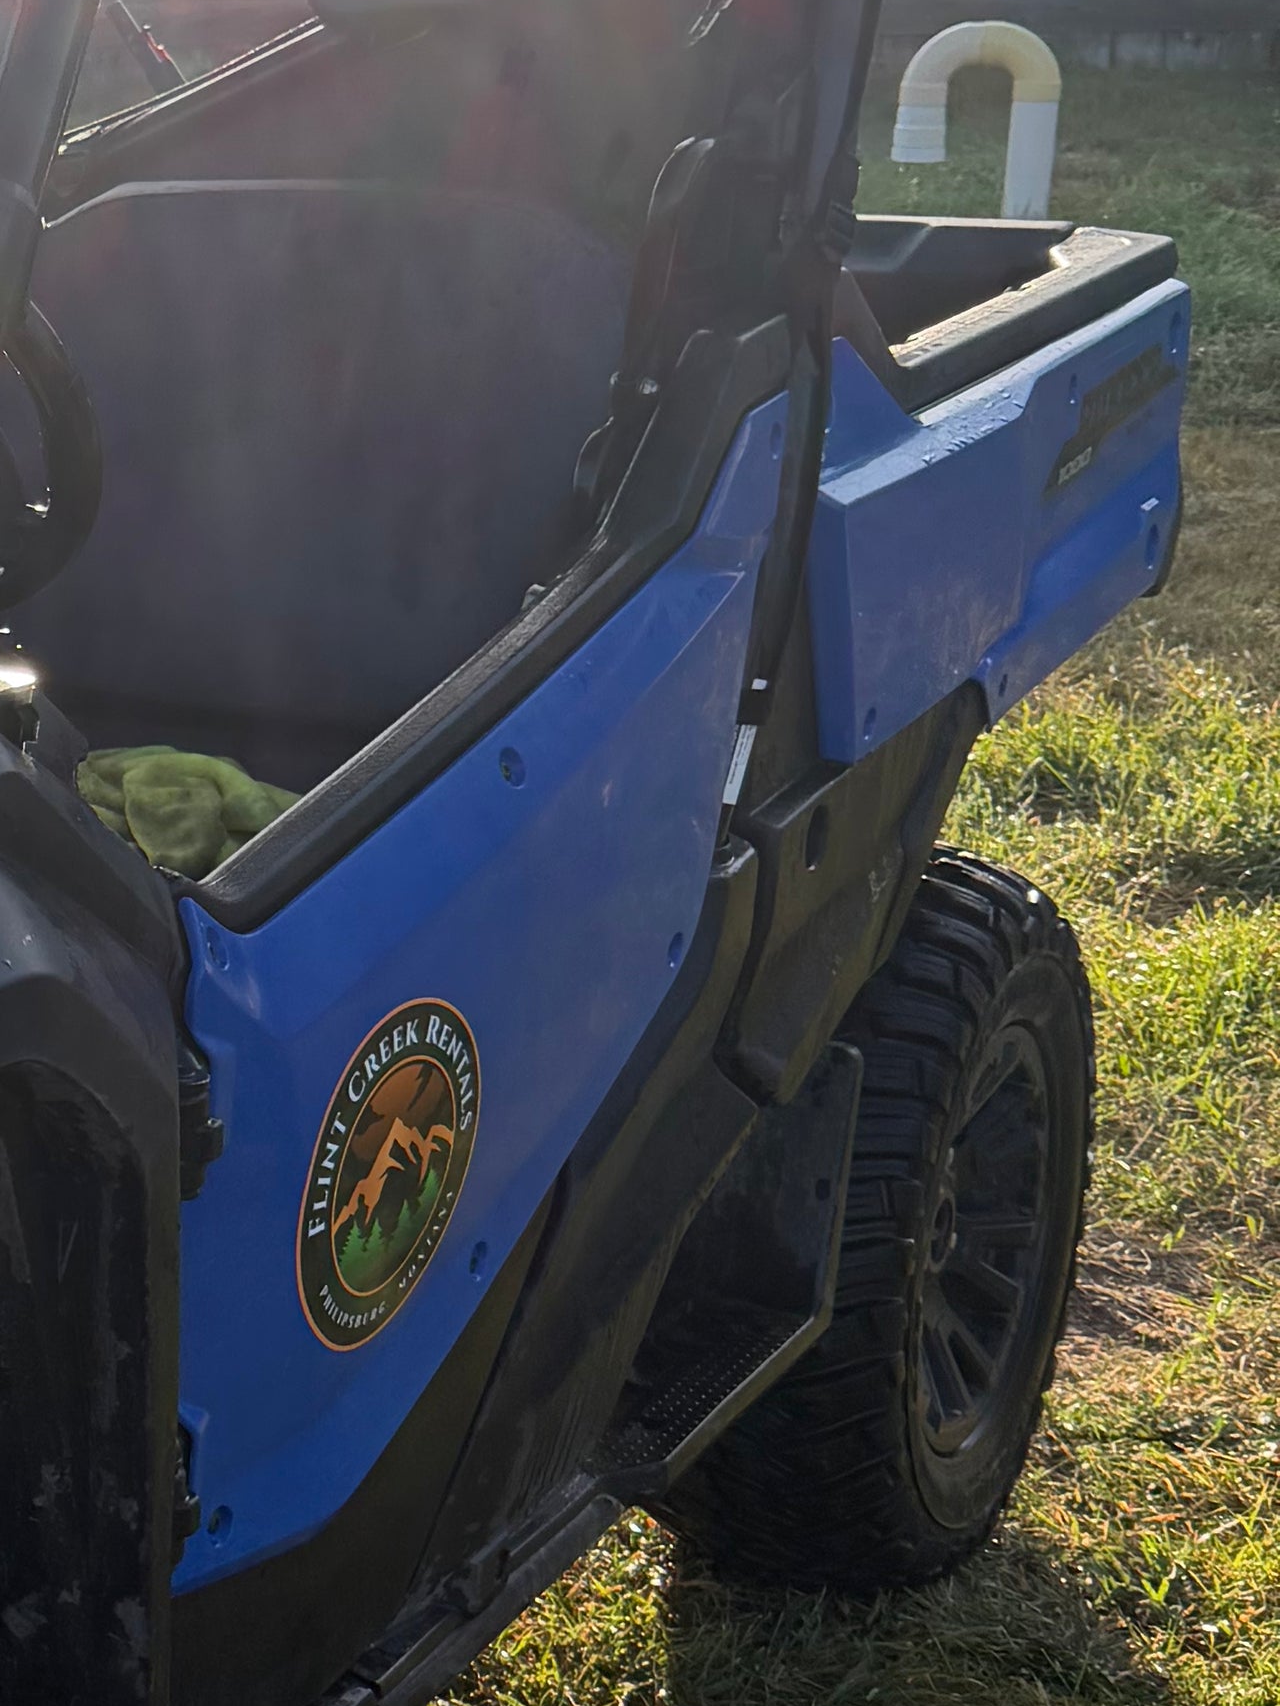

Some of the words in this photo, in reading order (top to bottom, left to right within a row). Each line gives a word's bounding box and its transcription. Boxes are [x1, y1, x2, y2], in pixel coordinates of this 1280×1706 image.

[307, 1111, 347, 1239] FLINT
[347, 1016, 420, 1103] CREEK
[424, 1013, 474, 1133] RENTALS
